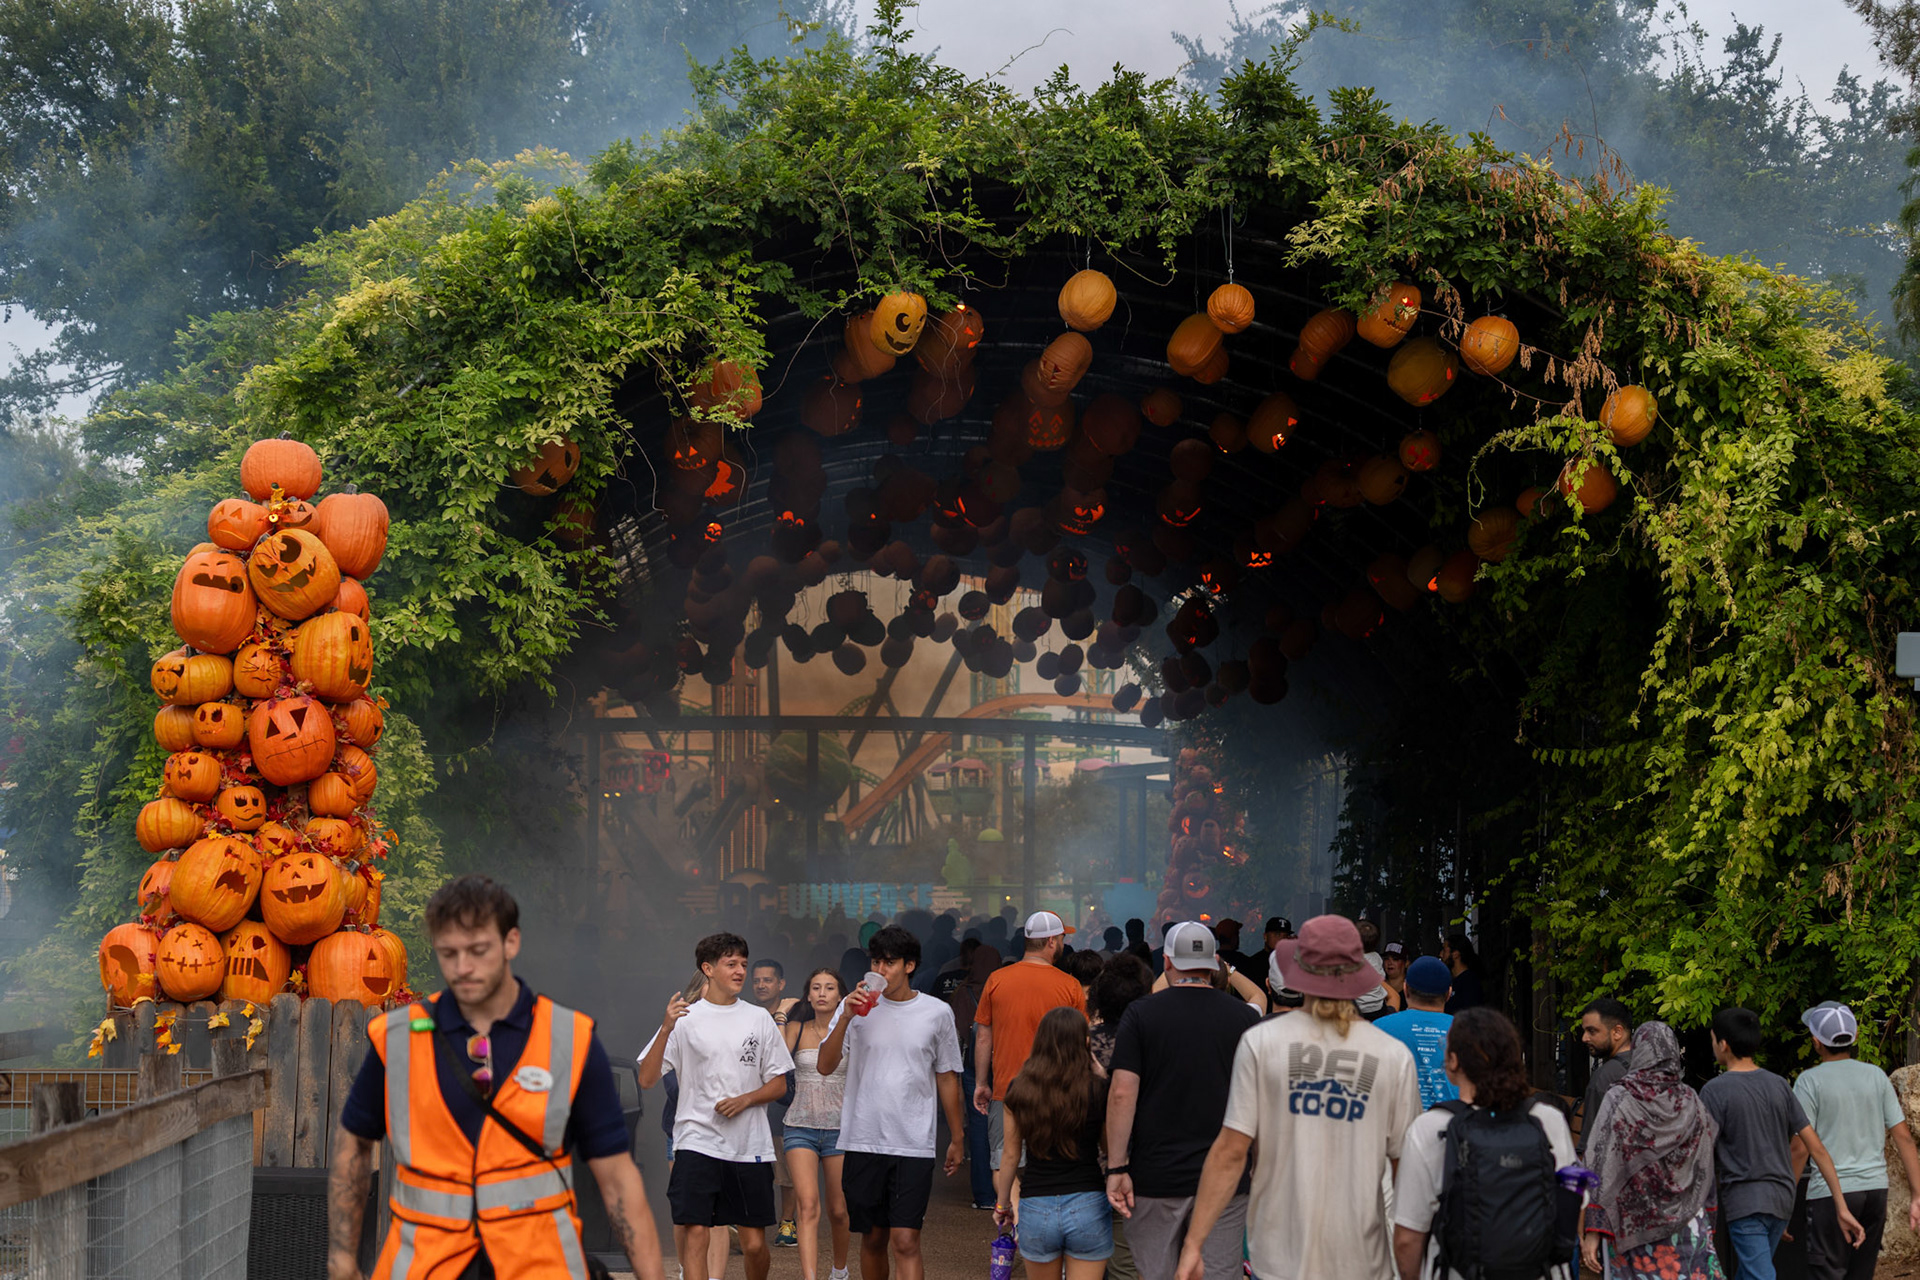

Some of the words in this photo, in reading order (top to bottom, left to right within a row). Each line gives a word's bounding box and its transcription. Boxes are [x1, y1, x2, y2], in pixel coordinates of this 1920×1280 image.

[786, 882, 935, 919] UNIVERSE
[1279, 919, 1287, 928] T
[1288, 1043, 1380, 1094] REI
